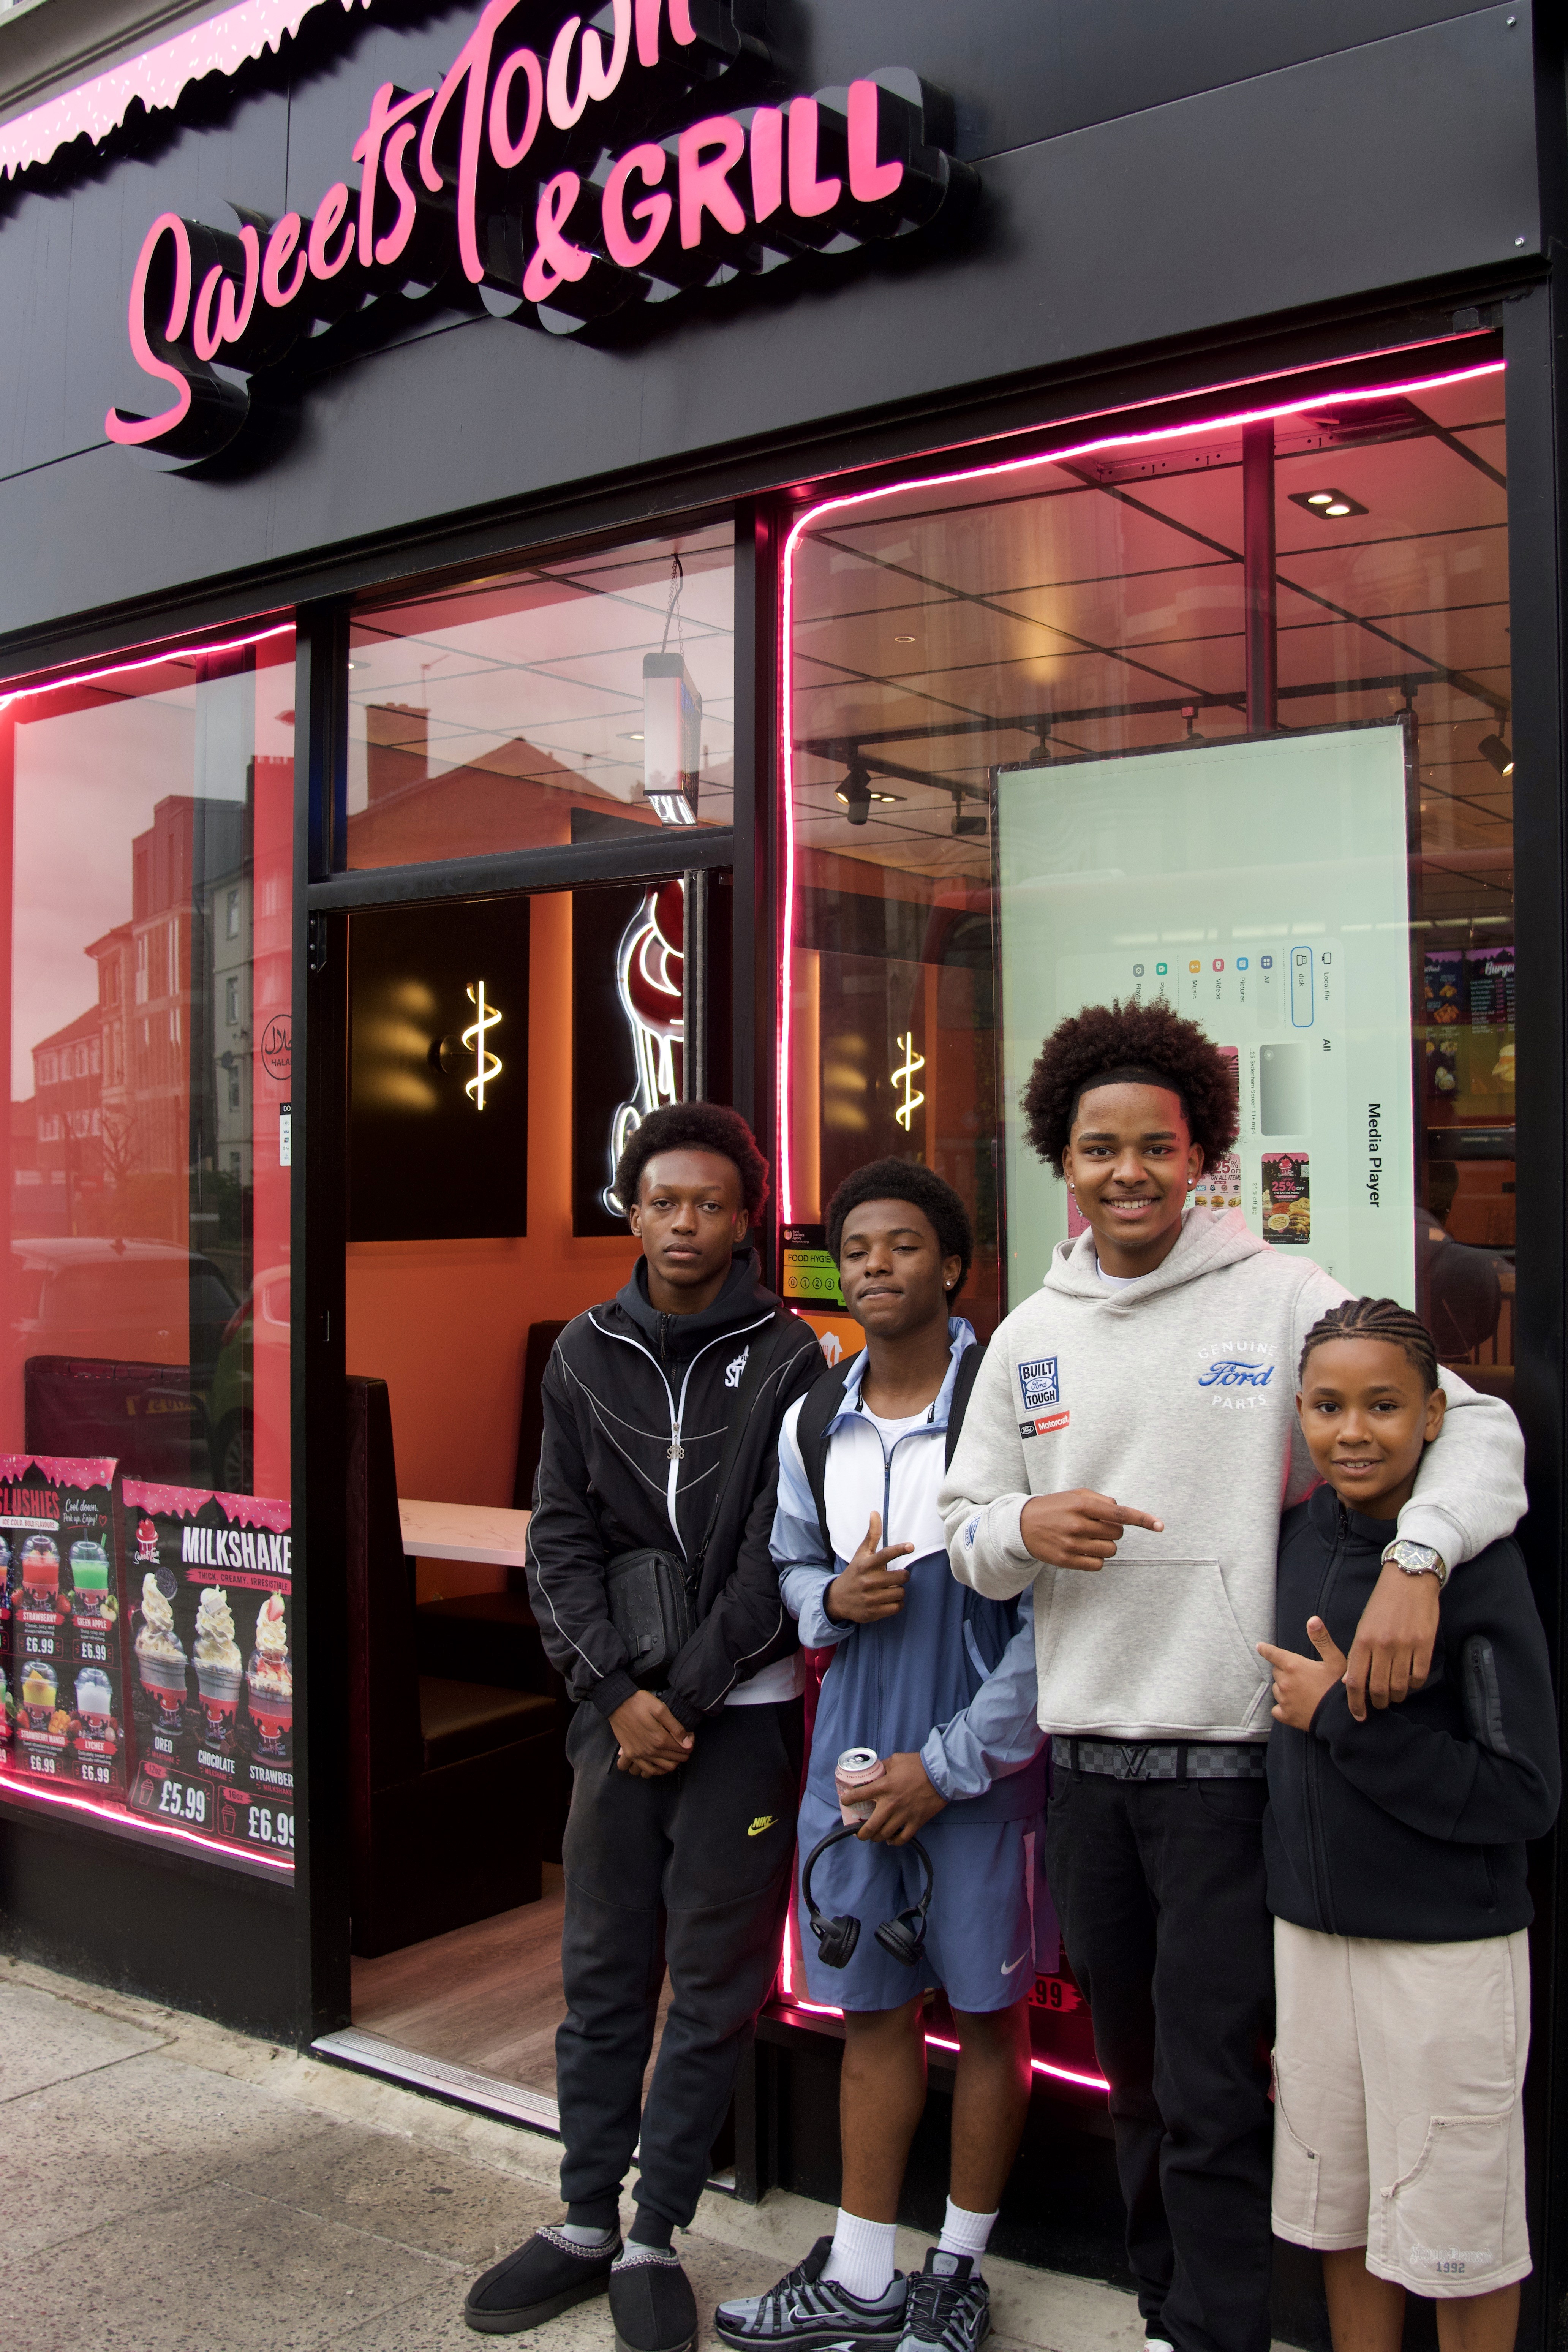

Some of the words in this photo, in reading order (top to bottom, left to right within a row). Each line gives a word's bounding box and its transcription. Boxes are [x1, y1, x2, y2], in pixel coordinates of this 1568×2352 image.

[523, 172, 592, 302] &
[602, 80, 903, 267] GRILL
[272, 1058, 291, 1067] HALA
[1368, 1103, 1381, 1152] Media
[1272, 1181, 1296, 1191] 25%
[1366, 1158, 1382, 1208] Player
[1198, 1340, 1277, 1359] GENUINE
[1023, 1362, 1053, 1380] BUILT
[1198, 1360, 1275, 1386] Ford
[1031, 1379, 1047, 1390] Ford
[1027, 1390, 1055, 1405] TOUGH
[1212, 1394, 1266, 1410] PARTS
[65, 1498, 79, 1513] Cool
[80, 1499, 99, 1512] down.
[82, 1513, 98, 1527] Enjoy!
[182, 1526, 292, 1574] MILKSHAKE
[198, 1572, 218, 1581] THICK.
[220, 1575, 248, 1584] CREAMY.
[251, 1578, 289, 1591] IRRESISTIBLE.
[23, 1611, 57, 1623] STRAWBERRY
[92, 1619, 107, 1629] APPLE
[26, 1636, 54, 1654] £6.99
[82, 1642, 106, 1661] £6.99
[85, 1740, 104, 1751] LYCHEE
[155, 1736, 172, 1753] OREO
[30, 1755, 55, 1774] £6.99
[198, 1749, 235, 1774] CHOCOLATE
[82, 1764, 109, 1784] £6.99
[159, 1780, 206, 1822] £5.99
[228, 1790, 243, 1801] 16oz
[752, 1815, 772, 1828] NIKE
[1437, 2262, 1465, 2273] 1992
